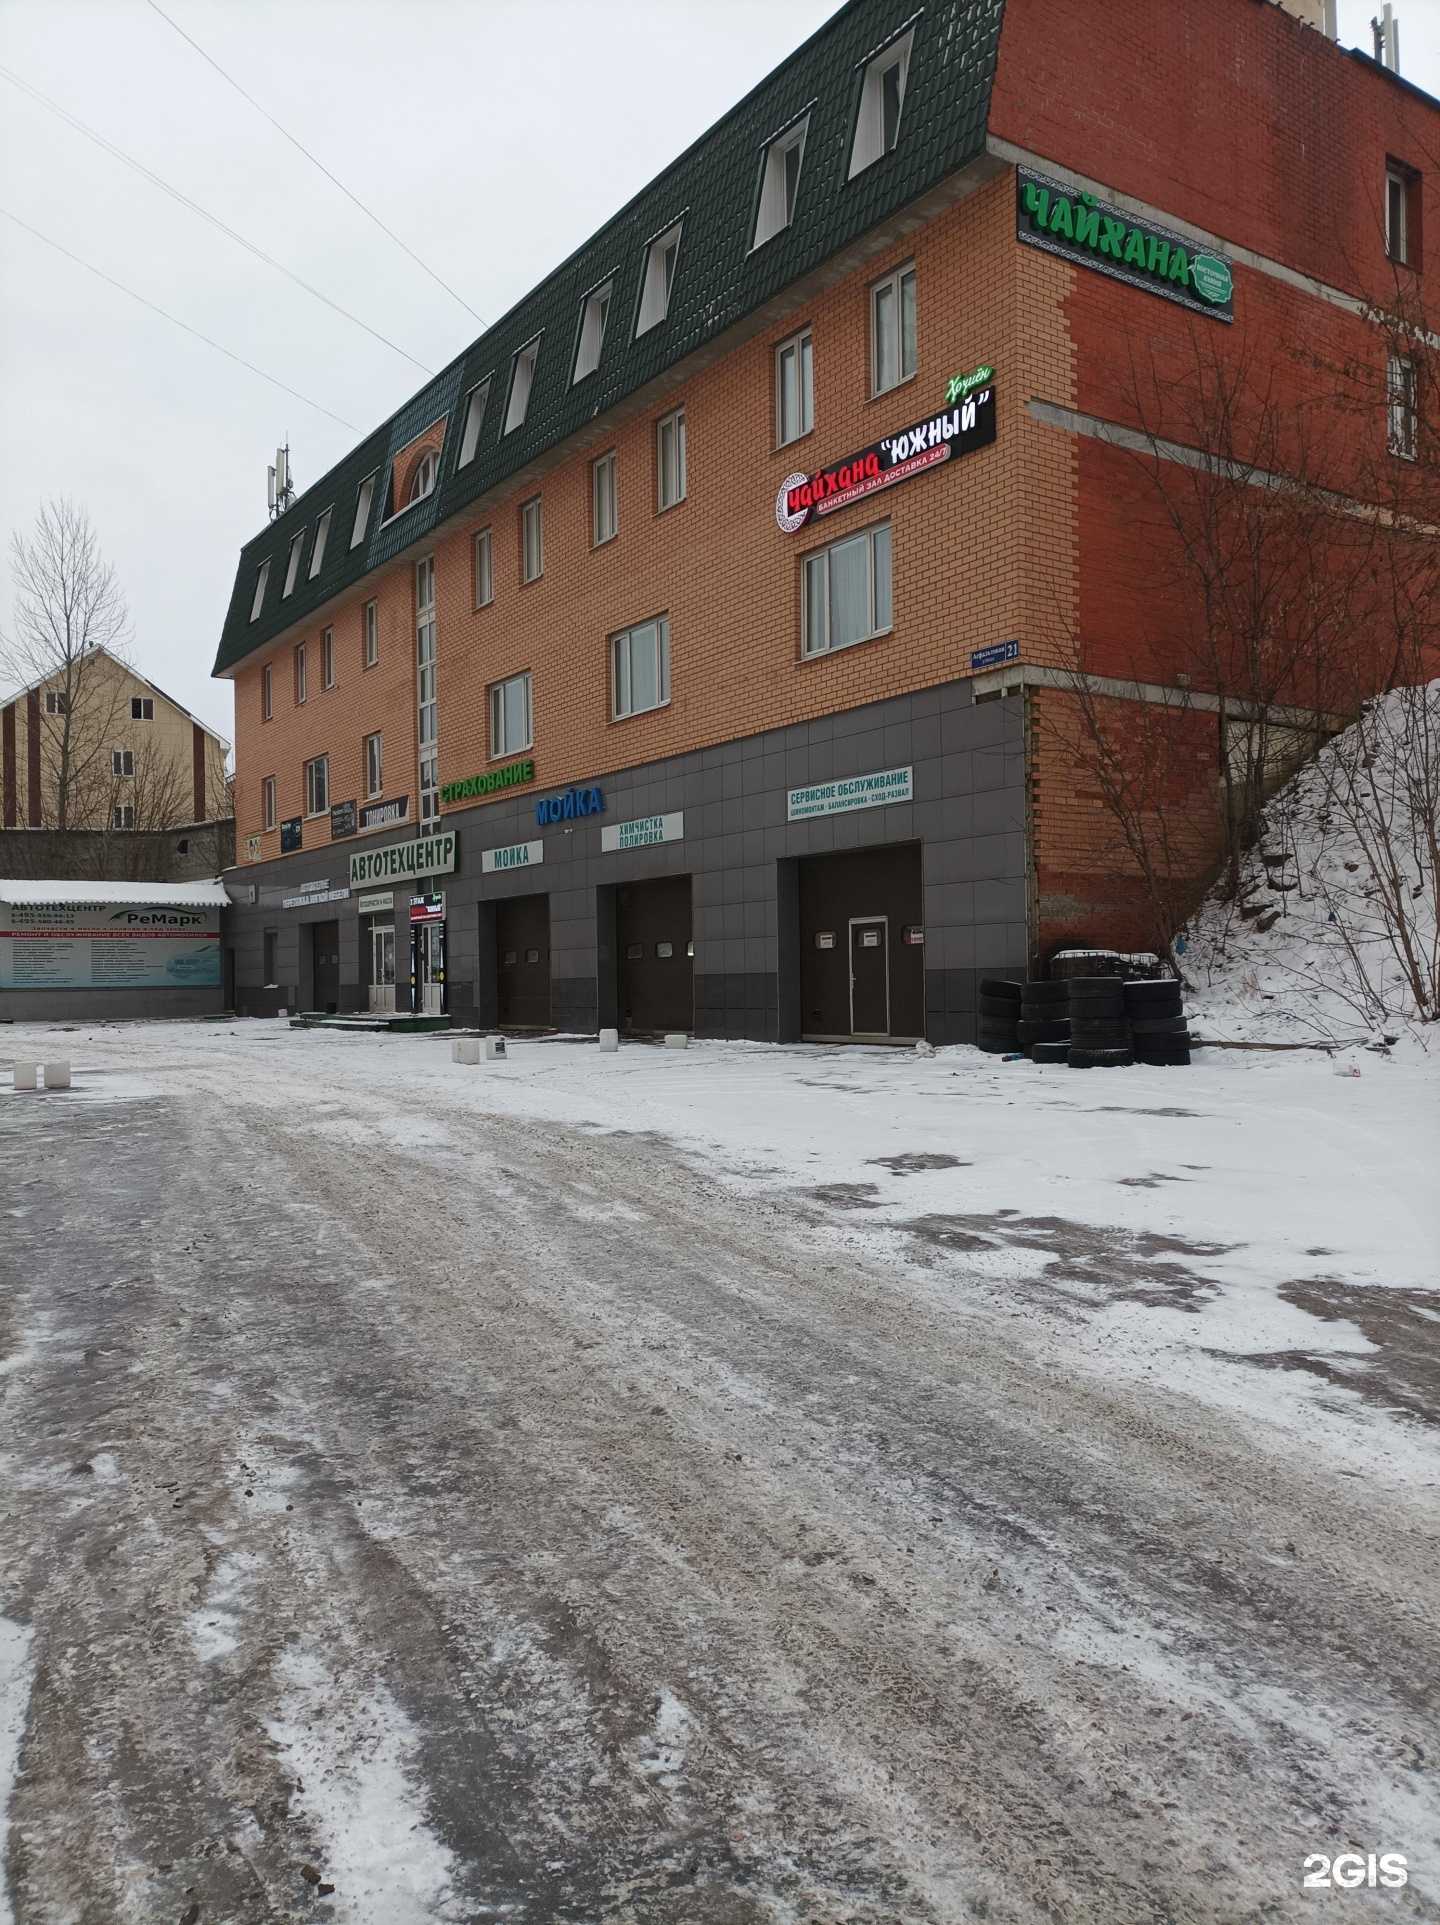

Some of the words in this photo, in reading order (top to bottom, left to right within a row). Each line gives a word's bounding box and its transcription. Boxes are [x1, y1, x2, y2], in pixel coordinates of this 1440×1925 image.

[1022, 182, 1190, 285] ЧАЙХАНА
[818, 485, 864, 512] БАНКЕТНЫЙ
[866, 478, 882, 490] ЗАЛ
[882, 458, 927, 483] ДОСТАВКА
[929, 447, 947, 461] 24/7
[1007, 643, 1018, 657] 21
[441, 763, 533, 801] СТРАХОВАНИЕ
[791, 786, 835, 804] СЕРВИСНОЕ
[838, 771, 908, 796] ОБСЛУЖИВАНИЕ
[535, 788, 603, 826] МОЙКА
[828, 796, 867, 810] БАЛАНСИРОВКА
[871, 788, 909, 802] СХОД-РАЗВАЛ
[366, 802, 400, 827] ТОНИРОВКА
[619, 816, 663, 836] ХИМЧИСТКА
[619, 829, 663, 848] ПОЛИРОВКА
[351, 837, 453, 882] АВТОТЕХЦЕНТР
[494, 846, 529, 868] МОЙКА
[11, 903, 106, 912] АВТОТЕХЦЕНТР
[128, 913, 202, 926] РеМарк
